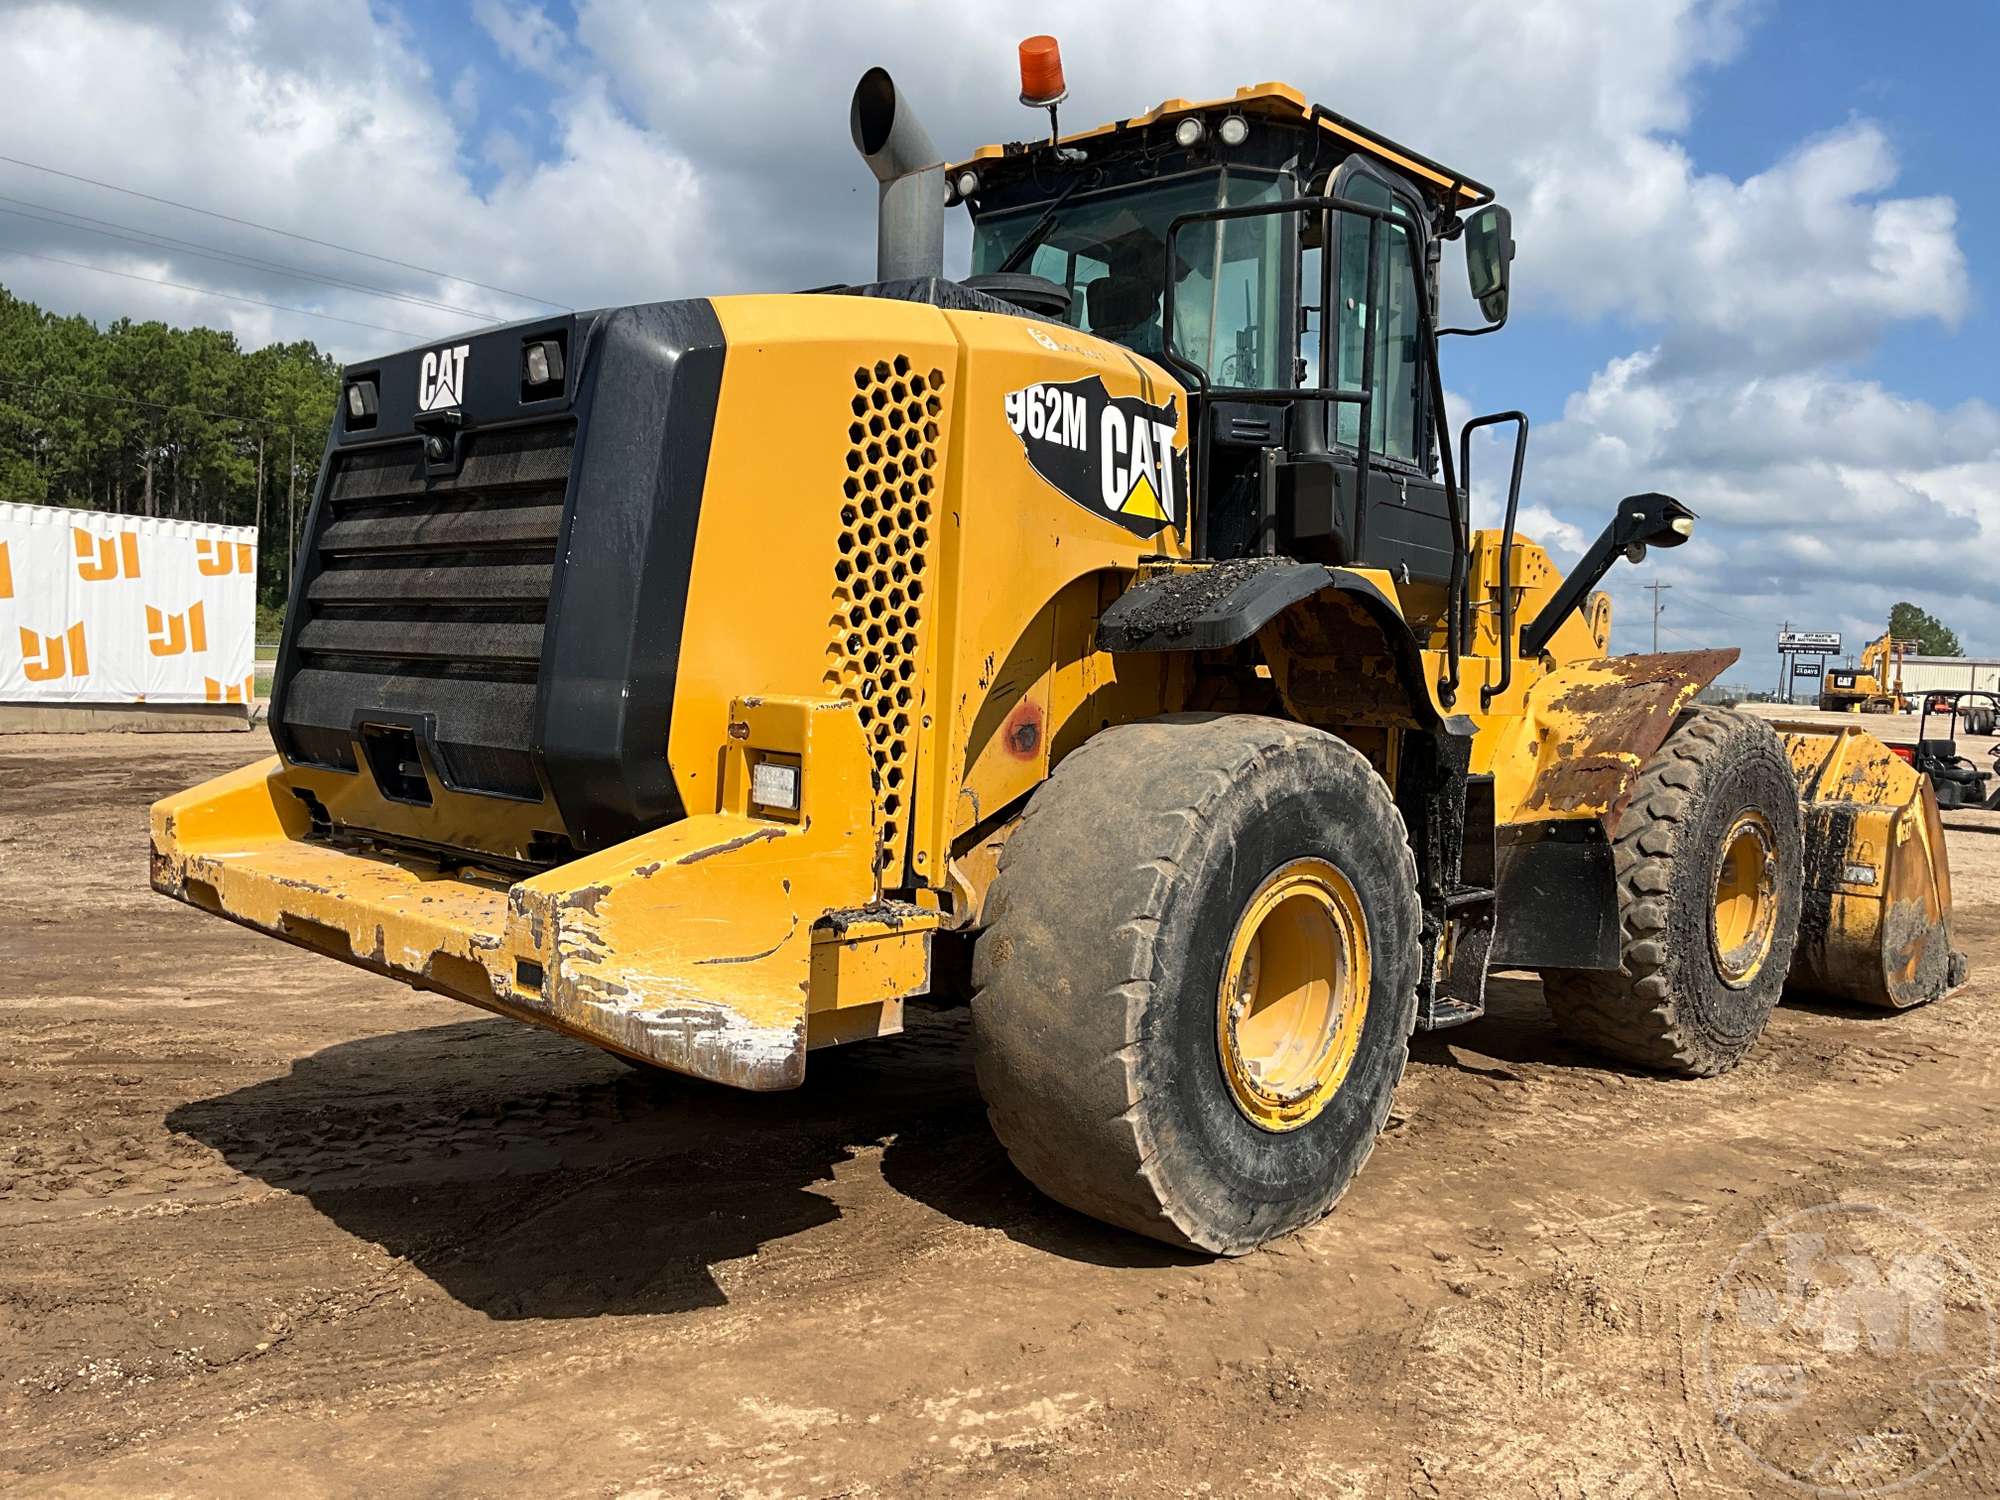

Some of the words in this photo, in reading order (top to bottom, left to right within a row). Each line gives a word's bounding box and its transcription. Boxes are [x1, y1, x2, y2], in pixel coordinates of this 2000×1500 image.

[420, 344, 470, 411] CAT
[1005, 384, 1087, 451] 962M
[1101, 404, 1177, 523] CAT
[1837, 676, 1852, 686] CAT
